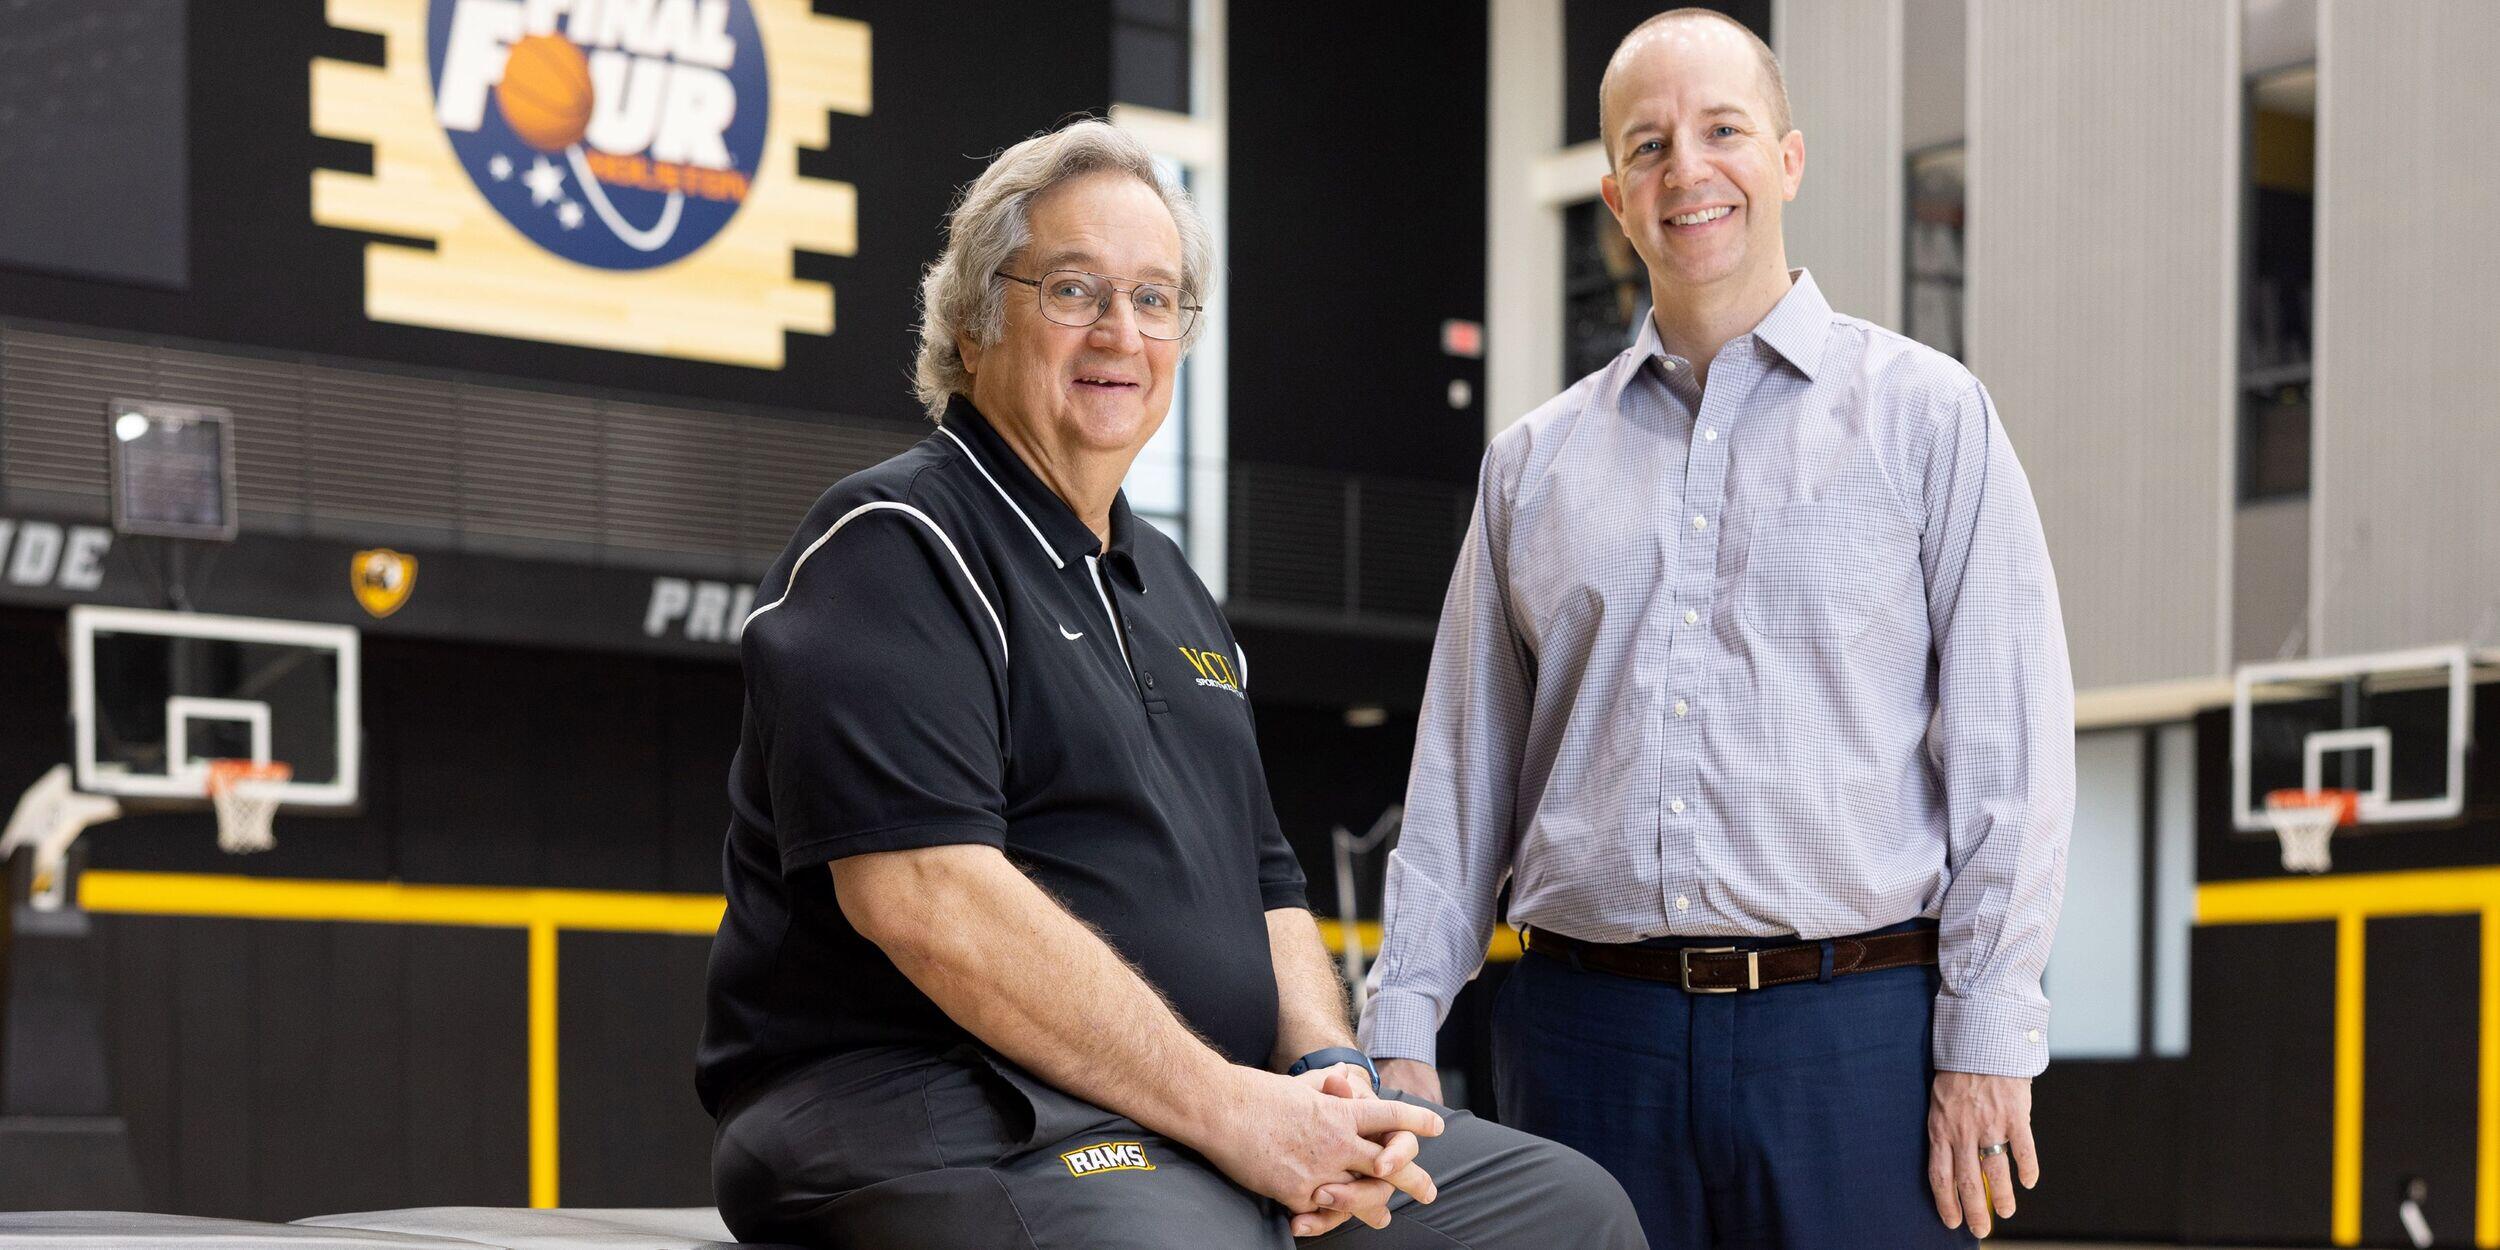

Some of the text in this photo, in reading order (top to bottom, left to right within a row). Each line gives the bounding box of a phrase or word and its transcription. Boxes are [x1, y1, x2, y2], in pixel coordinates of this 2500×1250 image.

[521, 0, 737, 70] FINAL
[1178, 646, 1238, 690] VCU
[1065, 1144, 1148, 1174] RAMS
